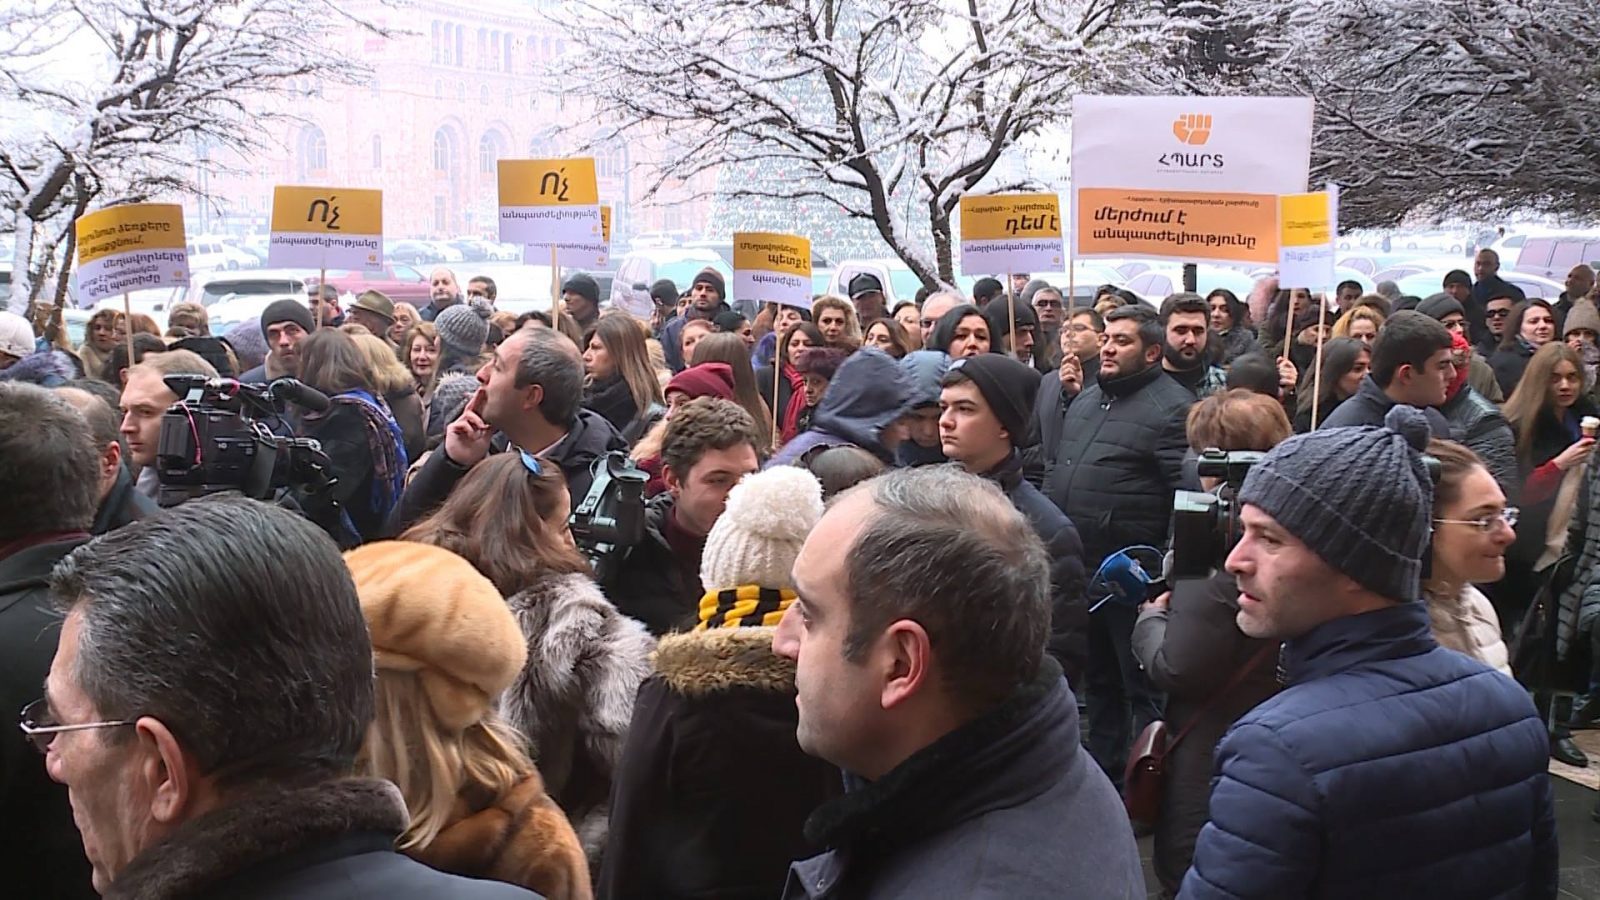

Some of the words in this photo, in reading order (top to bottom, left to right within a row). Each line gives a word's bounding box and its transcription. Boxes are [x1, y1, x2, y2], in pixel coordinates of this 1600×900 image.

[1158, 152, 1224, 168] ՀՊԱՐՏ
[502, 210, 598, 220] անպատժելիությանը
[1094, 205, 1175, 225] մերժում
[1177, 208, 1189, 225] է
[1005, 214, 1047, 235] դեմ
[1049, 214, 1059, 231] է
[272, 236, 378, 249] անպատժելիությանը
[1093, 228, 1257, 249] անպատժելիությունը
[768, 253, 801, 269] պետք
[753, 274, 801, 288] պատժվեն
